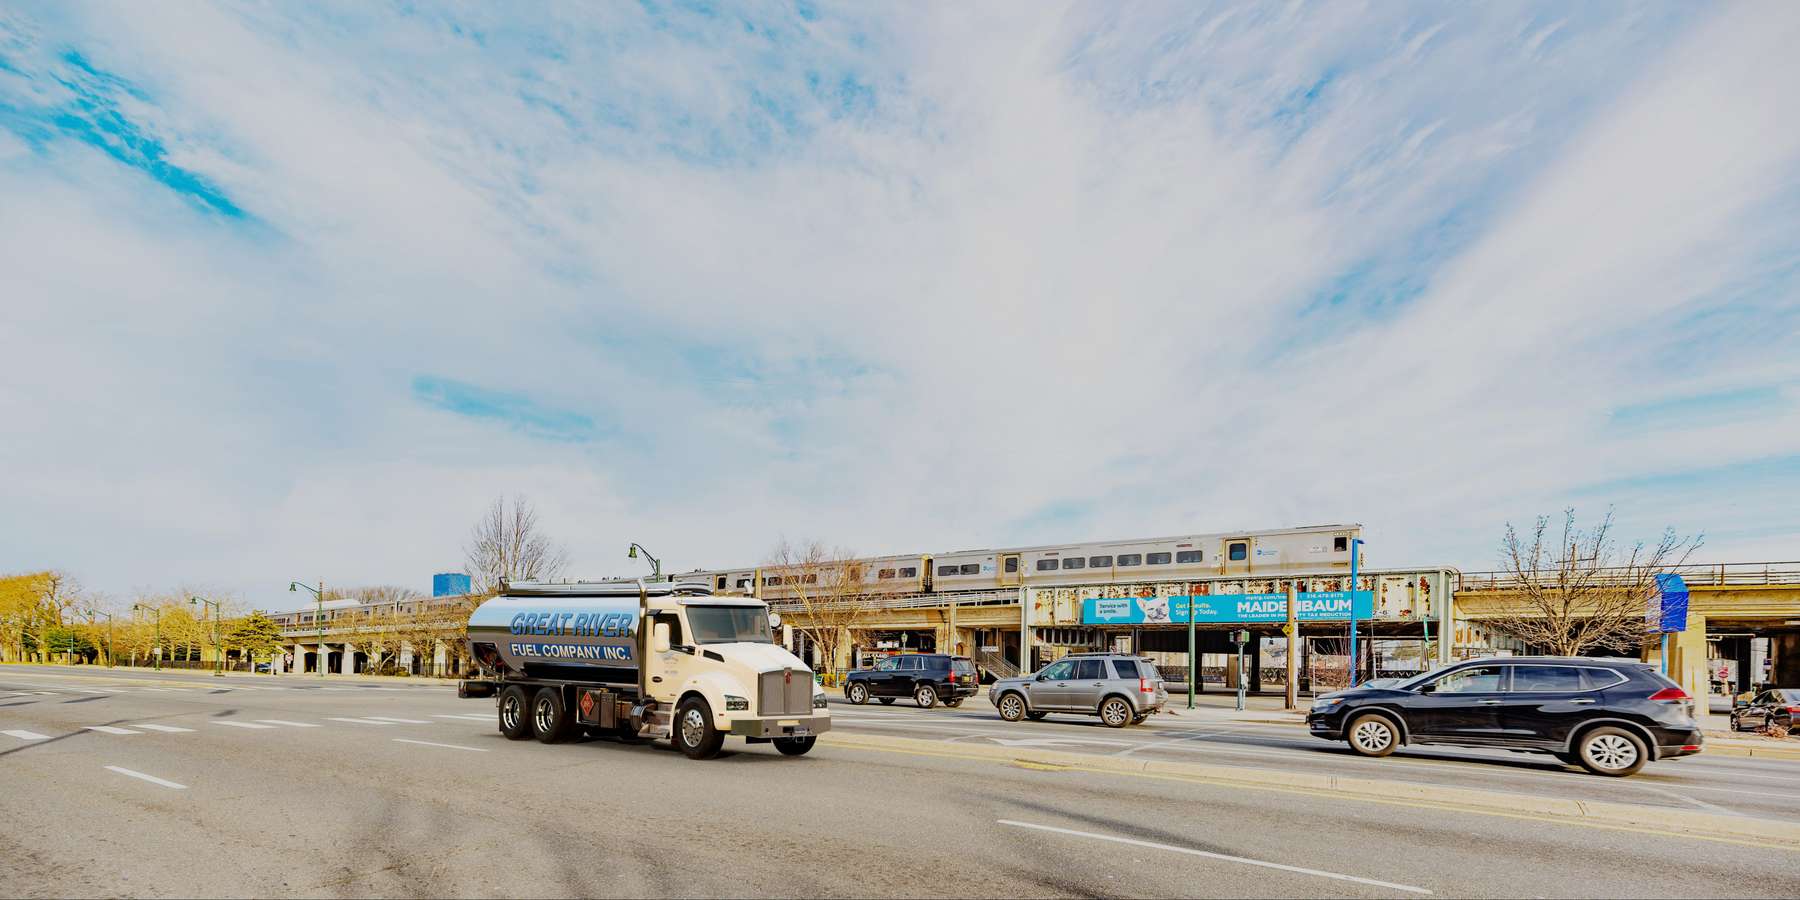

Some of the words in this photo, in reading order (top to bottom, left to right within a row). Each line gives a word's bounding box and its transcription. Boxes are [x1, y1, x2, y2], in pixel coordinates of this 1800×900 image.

[510, 612, 573, 636] GREAT
[573, 613, 632, 637] RIVER
[511, 644, 541, 656] FUEL
[542, 645, 600, 659] COMPANY
[603, 648, 630, 660] INC.
